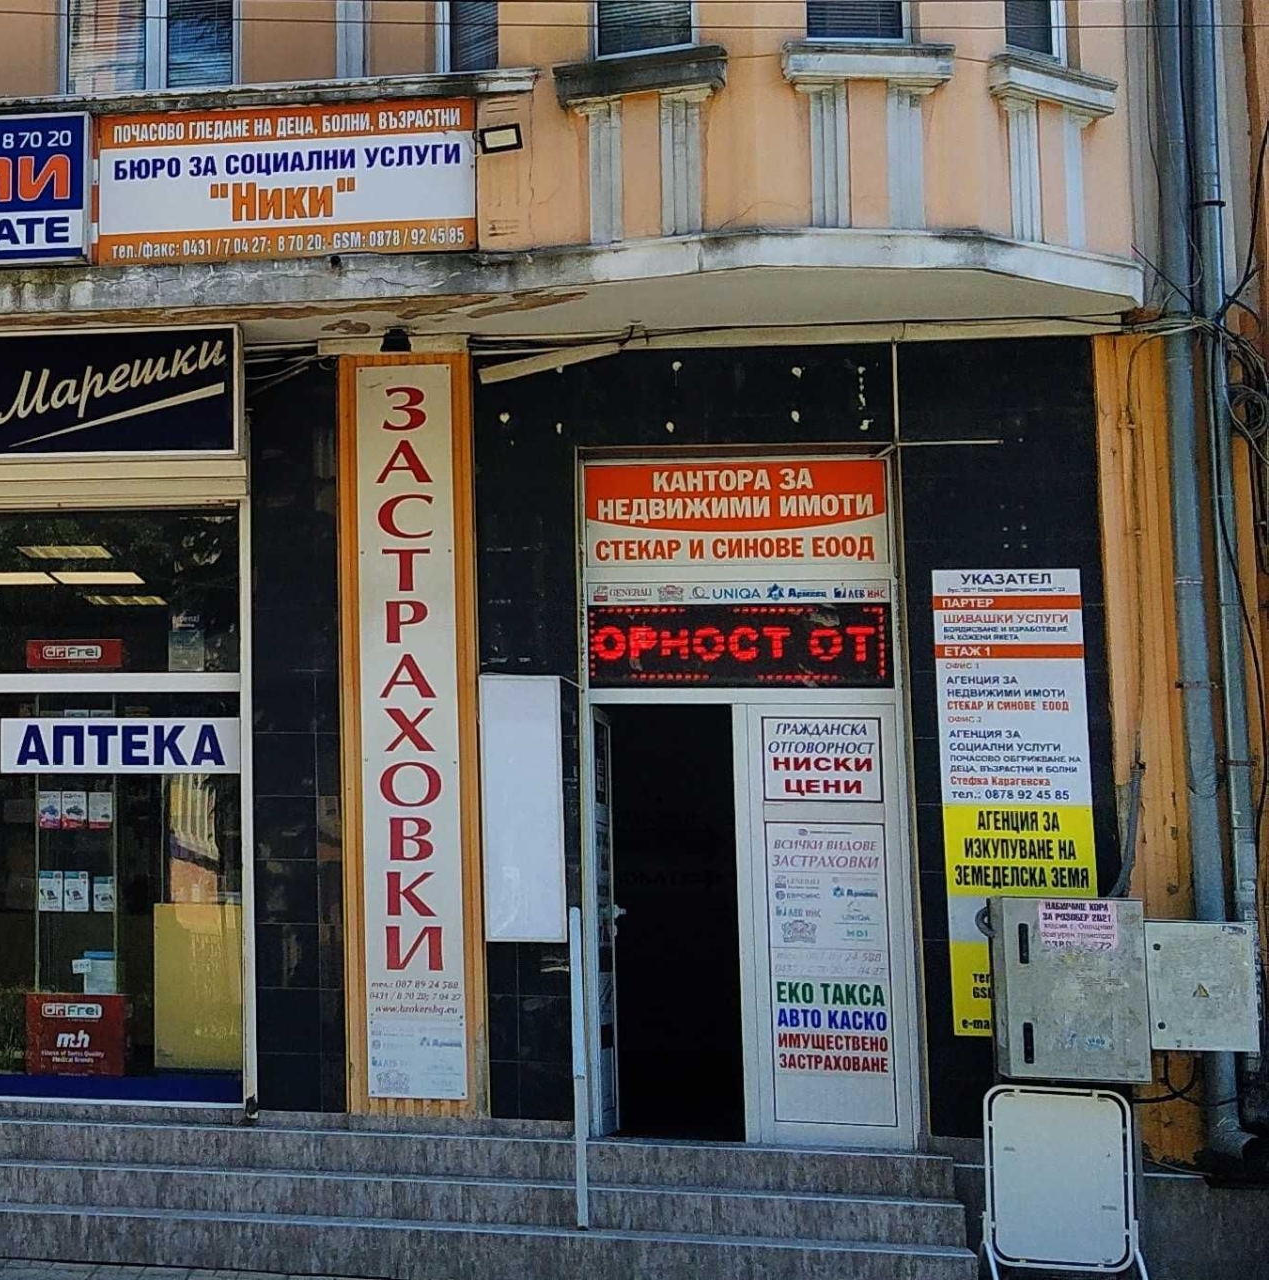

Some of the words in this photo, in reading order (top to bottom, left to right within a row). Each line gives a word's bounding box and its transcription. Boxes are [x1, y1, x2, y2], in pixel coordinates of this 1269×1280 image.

[114, 123, 184, 143] ПОЧАСОВО
[189, 120, 250, 140] ГЛЕДАНЕ
[254, 118, 272, 136] НА
[277, 115, 319, 136] ДЕЦА,
[322, 113, 374, 133] БОЛНИ,
[378, 108, 461, 130] ВЪЗРАСТНИ
[2, 133, 14, 150] 8
[18, 131, 42, 149] 70
[48, 130, 72, 147] 20
[114, 157, 181, 181] БЮРО
[189, 156, 217, 177] ЗА
[225, 149, 356, 176] СОЦИАЛНИ
[364, 144, 461, 169] УСЛУГИ
[183, 239, 211, 256] 0431
[223, 238, 231, 254] 7
[234, 237, 249, 253] 04
[278, 235, 285, 252] 8
[288, 235, 304, 251] 70
[333, 232, 365, 249] GSM:
[369, 230, 400, 246] 0878
[411, 228, 427, 244] 92
[430, 228, 445, 244] 45
[449, 227, 465, 243] 85
[653, 469, 771, 493] КАНТОРА
[779, 467, 813, 490] ЗА
[597, 495, 771, 524] НЕДВИЖИМИ
[779, 493, 874, 518] ИМОТИ
[595, 539, 681, 561] СТЕКАР
[689, 538, 704, 559] И
[712, 537, 804, 559] СИНОВЕ
[811, 536, 875, 561] ЕООД
[960, 573, 1052, 585] УКАЗАТЕЛ
[712, 588, 761, 599] UNIQA
[942, 598, 994, 608] ПАРТЕР
[943, 614, 1013, 624] ШИВАШКИ
[1017, 613, 1069, 624] УСЛУГИ
[594, 625, 792, 662] ОРНОСТ
[808, 625, 875, 662] ОТ
[944, 646, 981, 657] ЕТАЖ
[985, 646, 991, 656] 1
[375, 386, 444, 972] ЗАСТРАХОВКИ
[946, 676, 1000, 685] АГЕНЦИЯ
[1003, 676, 1018, 684] ЗА
[947, 689, 1021, 698] НЕДВИЖИМИ
[1024, 689, 1066, 698] ИМОТИ
[947, 701, 983, 710] СТЕКАР
[987, 701, 994, 710] И
[997, 701, 1036, 711] СИНОВЕ
[1042, 701, 1069, 712] ЕООД
[775, 723, 868, 737] ГРАЖДАНСКА
[949, 730, 1002, 739] АГЕНЦИЯ
[1005, 730, 1021, 738] ЗА
[16, 724, 226, 766] АПТЕКА
[768, 741, 875, 754] ОТГОВОРНОСТ
[949, 743, 1014, 752] СОЦИАЛНИ
[1017, 743, 1061, 752] УСЛУГИ
[773, 757, 873, 772] НИСКИ
[784, 779, 863, 796] ЦЕНИ
[950, 775, 989, 786] Стефка
[985, 790, 1014, 799] 0878
[1018, 790, 1032, 799] 92
[1036, 790, 1051, 799] 45
[1054, 790, 1069, 800] 85
[977, 810, 1039, 834] АГЕНЦИЯ
[1043, 811, 1060, 832] ЗА
[774, 839, 823, 850] ВСИЧКИ
[826, 840, 877, 851] ВИДОВЕ
[964, 838, 1054, 860] ИЗКУПУВАНЕ
[1058, 839, 1077, 860] НА
[772, 855, 880, 869] ЗАСТРАХОВКИ
[954, 865, 1047, 889] ЗЕМЕДЕЛСКА
[1051, 867, 1090, 889] ЗЕМЯ
[776, 981, 814, 1004] ЕКО
[820, 983, 885, 1006] ТАКСА
[777, 1008, 822, 1029] АВТО
[828, 1010, 887, 1031] КАСКО
[778, 1033, 888, 1052] ИМУЩЕСТВЕНО
[779, 1053, 888, 1073] ЗАСТРАХОВАНЕ
